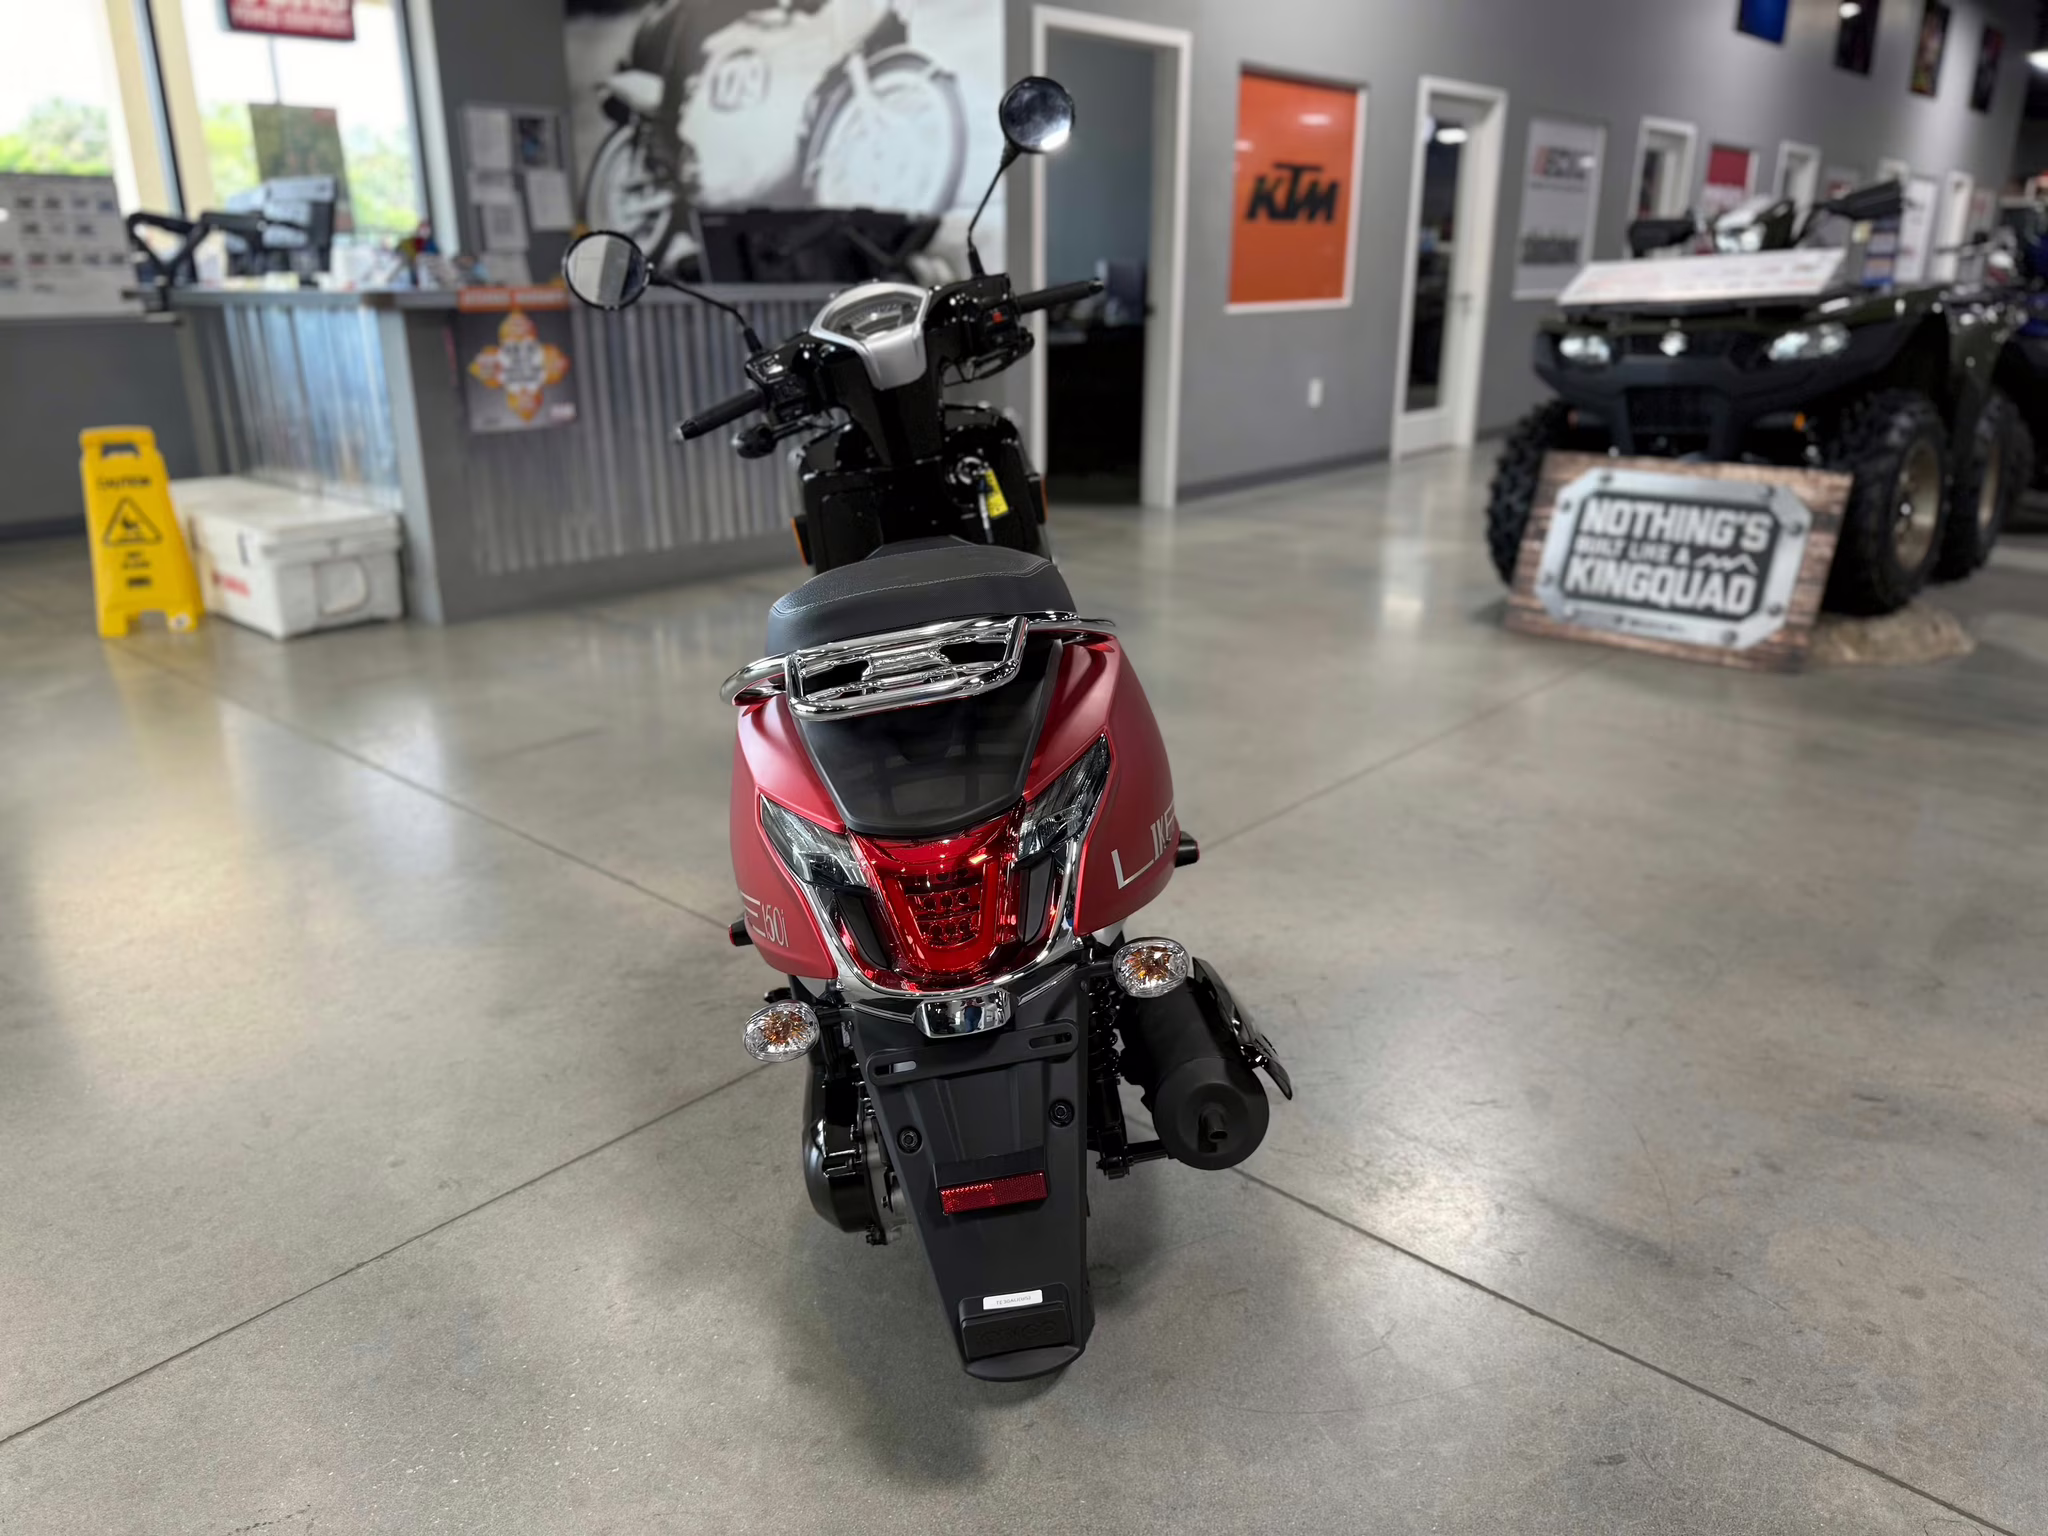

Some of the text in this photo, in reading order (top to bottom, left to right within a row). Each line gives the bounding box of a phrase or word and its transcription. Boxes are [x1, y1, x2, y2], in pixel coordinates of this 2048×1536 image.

[1246, 162, 1340, 221] KTM
[1580, 498, 1773, 552] NOTHING'S
[1674, 546, 1691, 567] A
[1564, 553, 1757, 617] KINGQUAD
